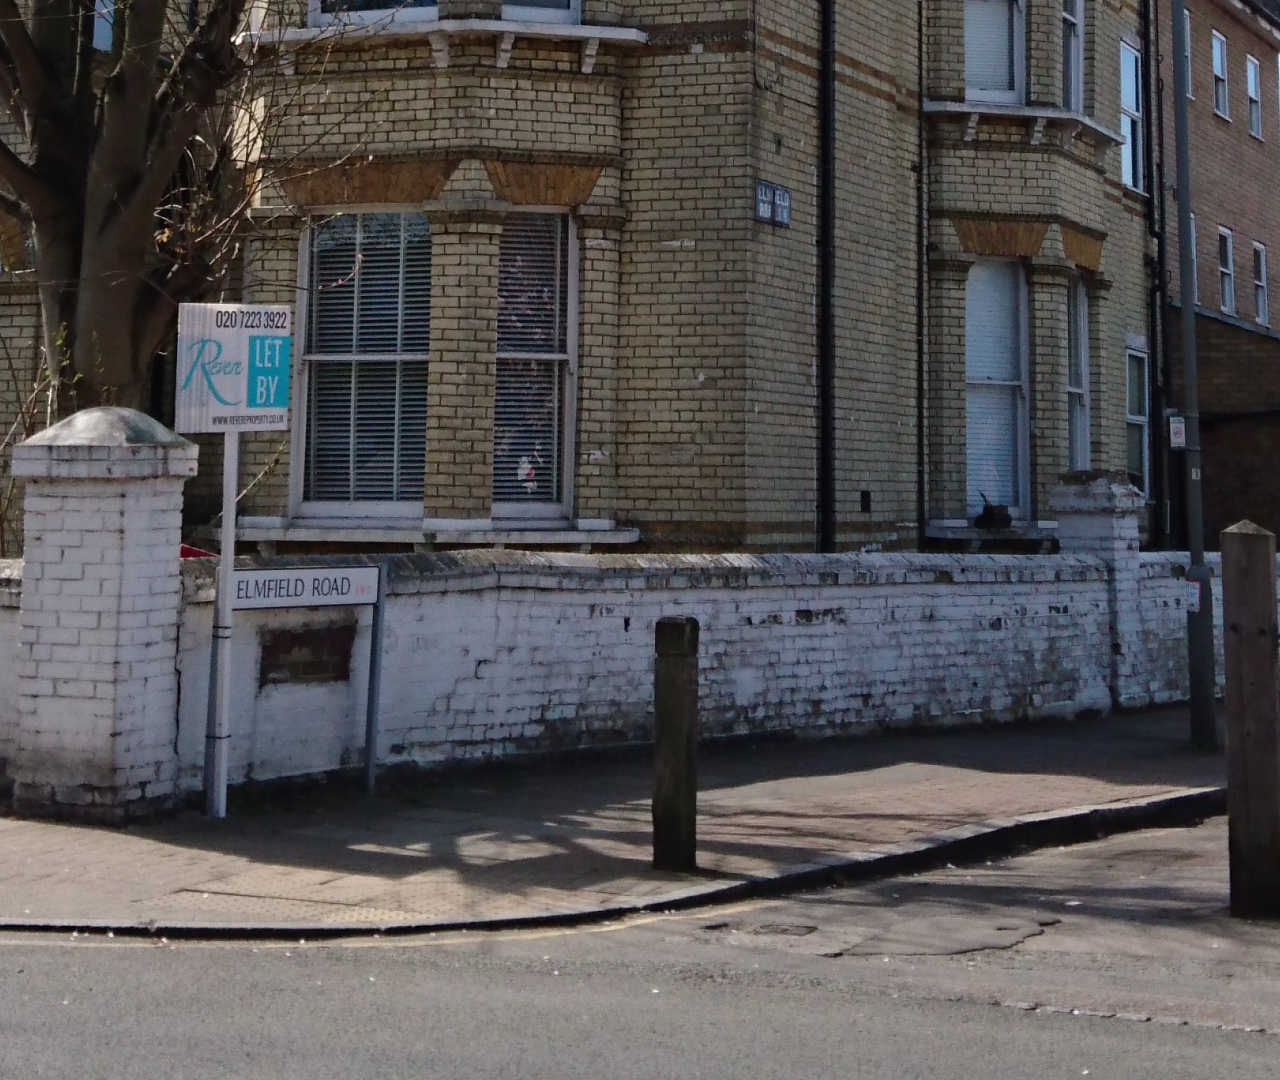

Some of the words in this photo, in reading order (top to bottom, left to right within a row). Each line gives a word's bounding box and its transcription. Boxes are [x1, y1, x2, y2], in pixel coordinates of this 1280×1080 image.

[215, 310, 237, 328] 020
[239, 311, 262, 328] 7223
[263, 311, 287, 329] 3922
[255, 339, 283, 368] LET
[181, 337, 244, 407] Revere
[256, 375, 279, 405] BY
[236, 578, 305, 599] ELMFIELD
[312, 576, 351, 597] ROAD
